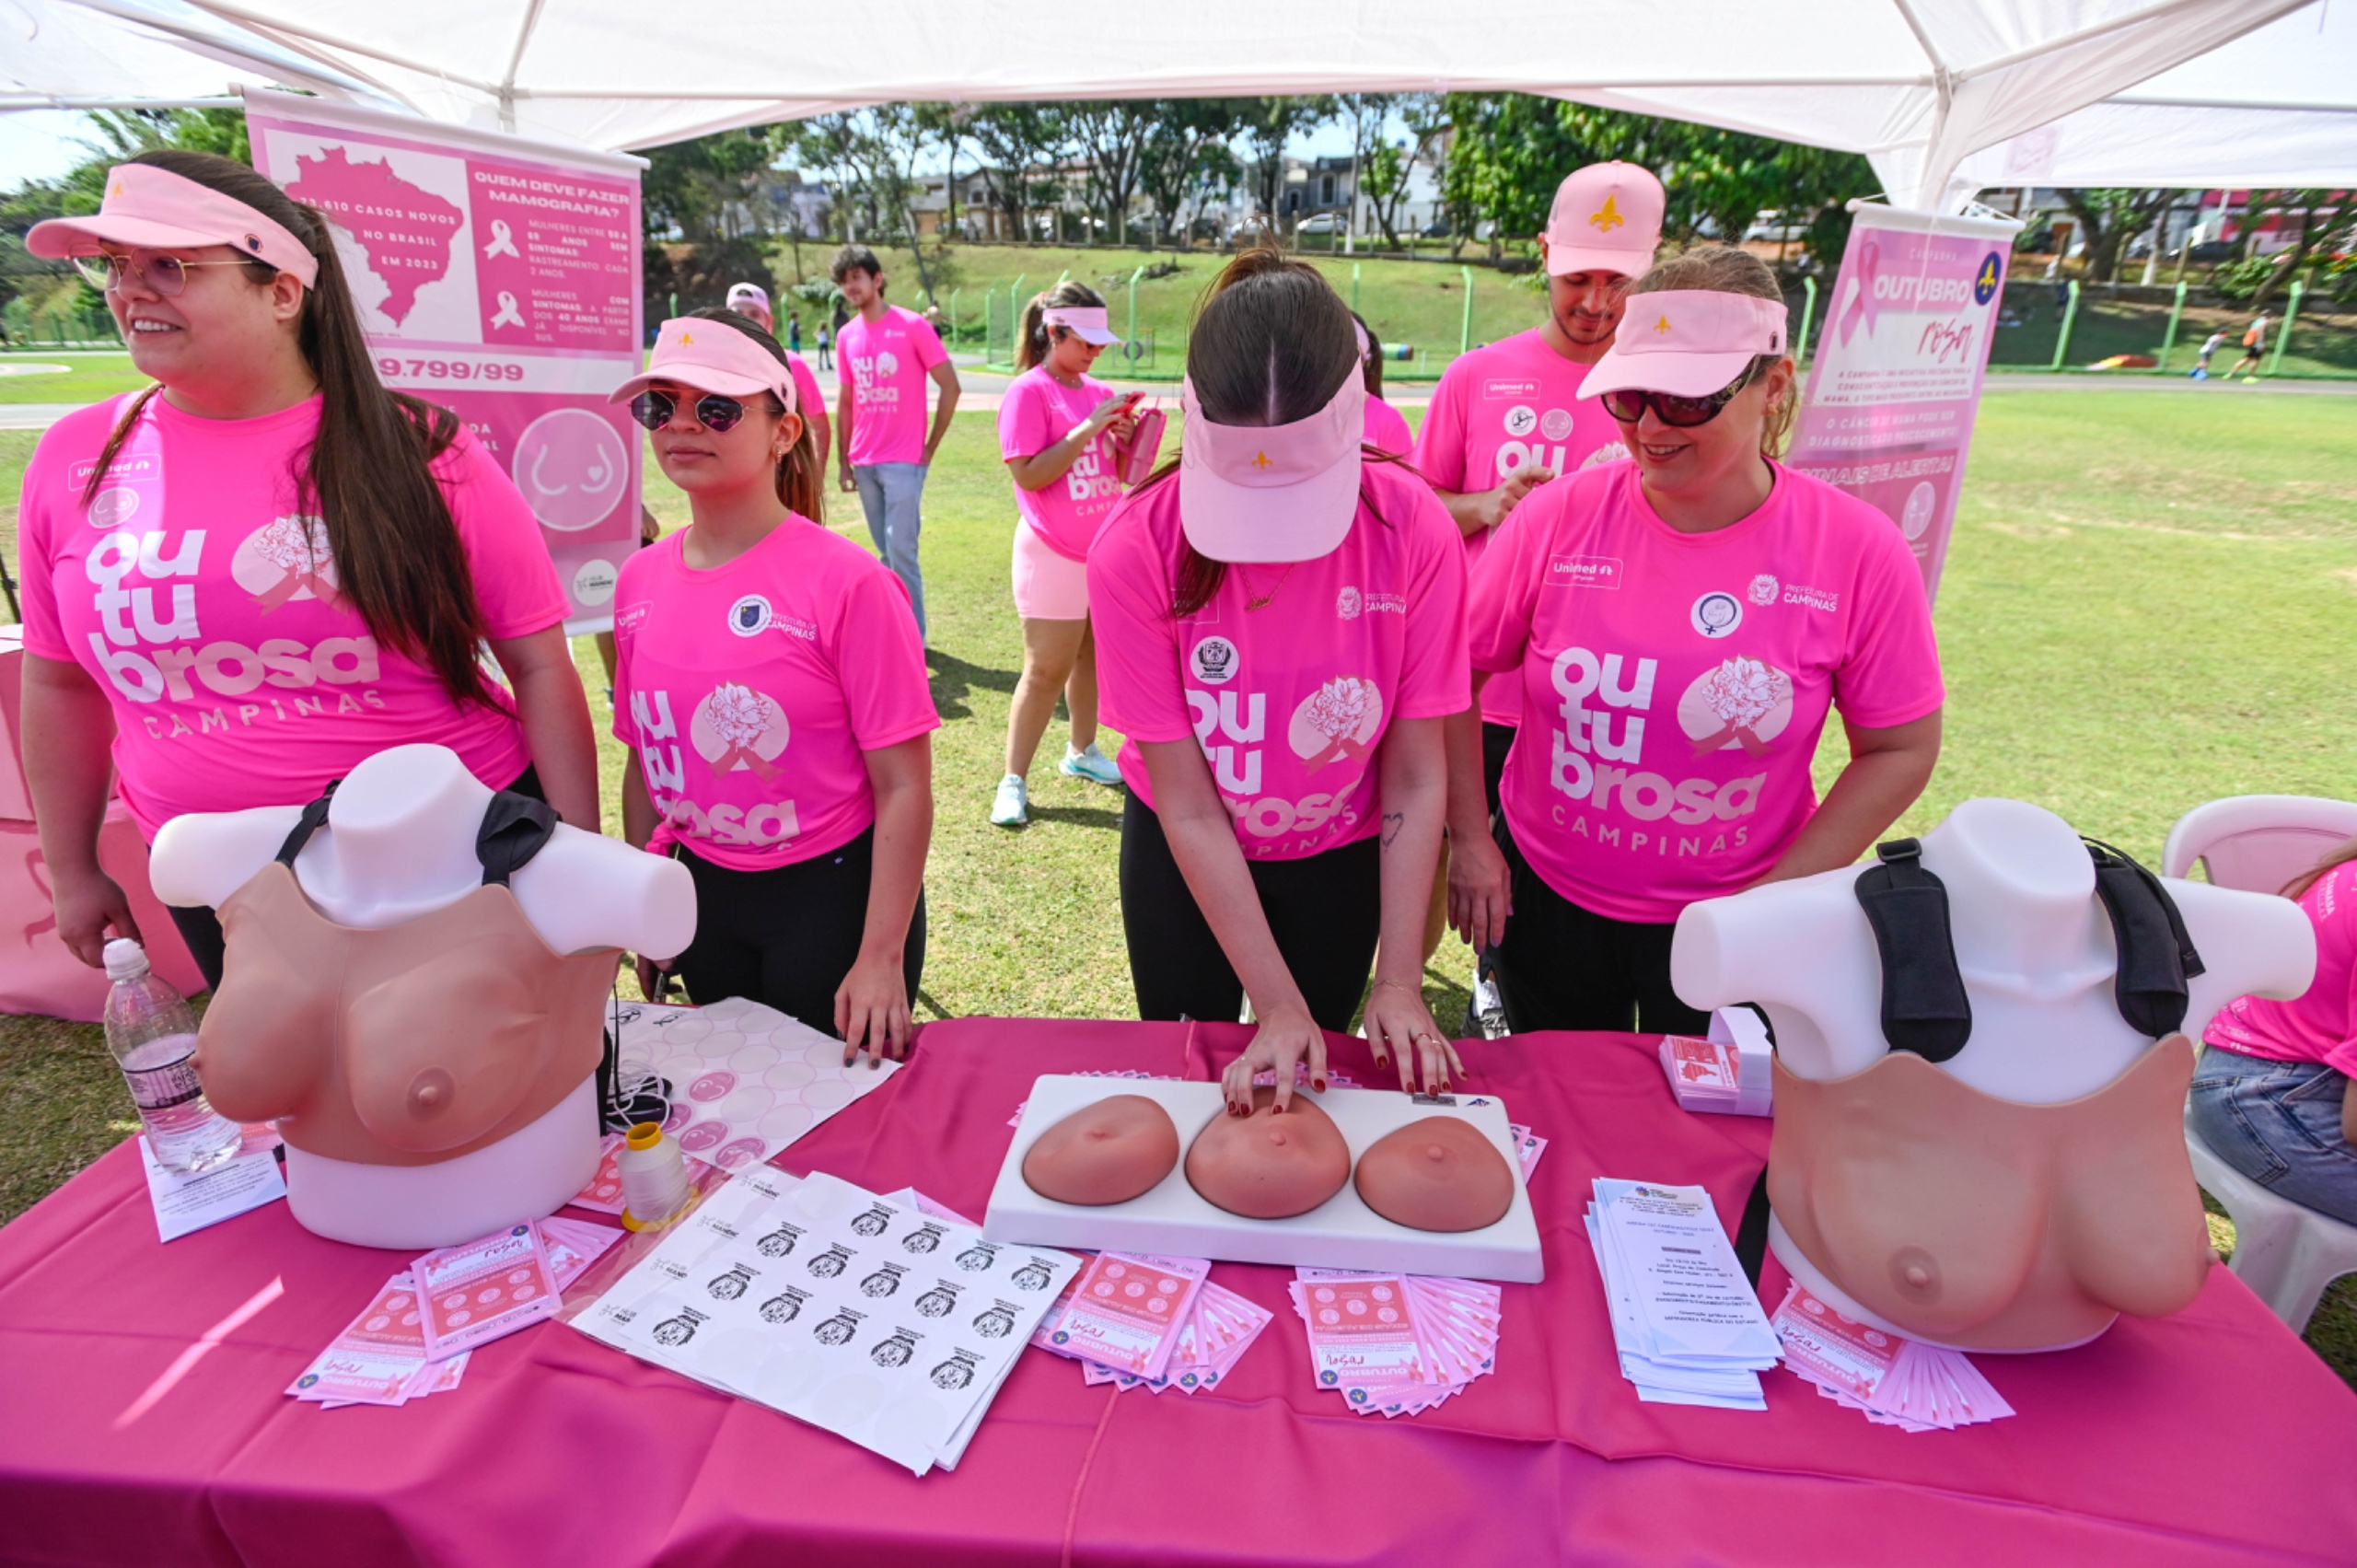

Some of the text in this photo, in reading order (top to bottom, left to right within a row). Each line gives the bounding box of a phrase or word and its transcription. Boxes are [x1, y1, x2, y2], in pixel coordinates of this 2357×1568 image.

[474, 170, 630, 204] QUEM DEVE FAZER
[489, 190, 620, 218] MAMOGRAFIA?
[355, 203, 403, 218] CASOS
[409, 211, 457, 225] NOVOS
[528, 220, 576, 233] MULHERES
[578, 226, 606, 237] ENTRE
[363, 229, 437, 247] NO BRASIL
[562, 236, 588, 247] ANOS
[610, 242, 628, 251] SEM
[381, 256, 438, 270] EM 2023
[605, 263, 628, 273] CADA
[531, 288, 630, 305] MULHERES COM
[1874, 274, 1970, 303] OUTUBRO
[558, 313, 570, 322] 40
[575, 314, 599, 324] ANOS
[1553, 563, 1597, 575] Unimed
[87, 632, 380, 703] brosa
[145, 690, 386, 739] CAMPINAS
[1550, 728, 1767, 825] brosa
[1552, 805, 1748, 857] CAMPINAS
[1340, 1366, 1409, 1376] OUTUBRO
